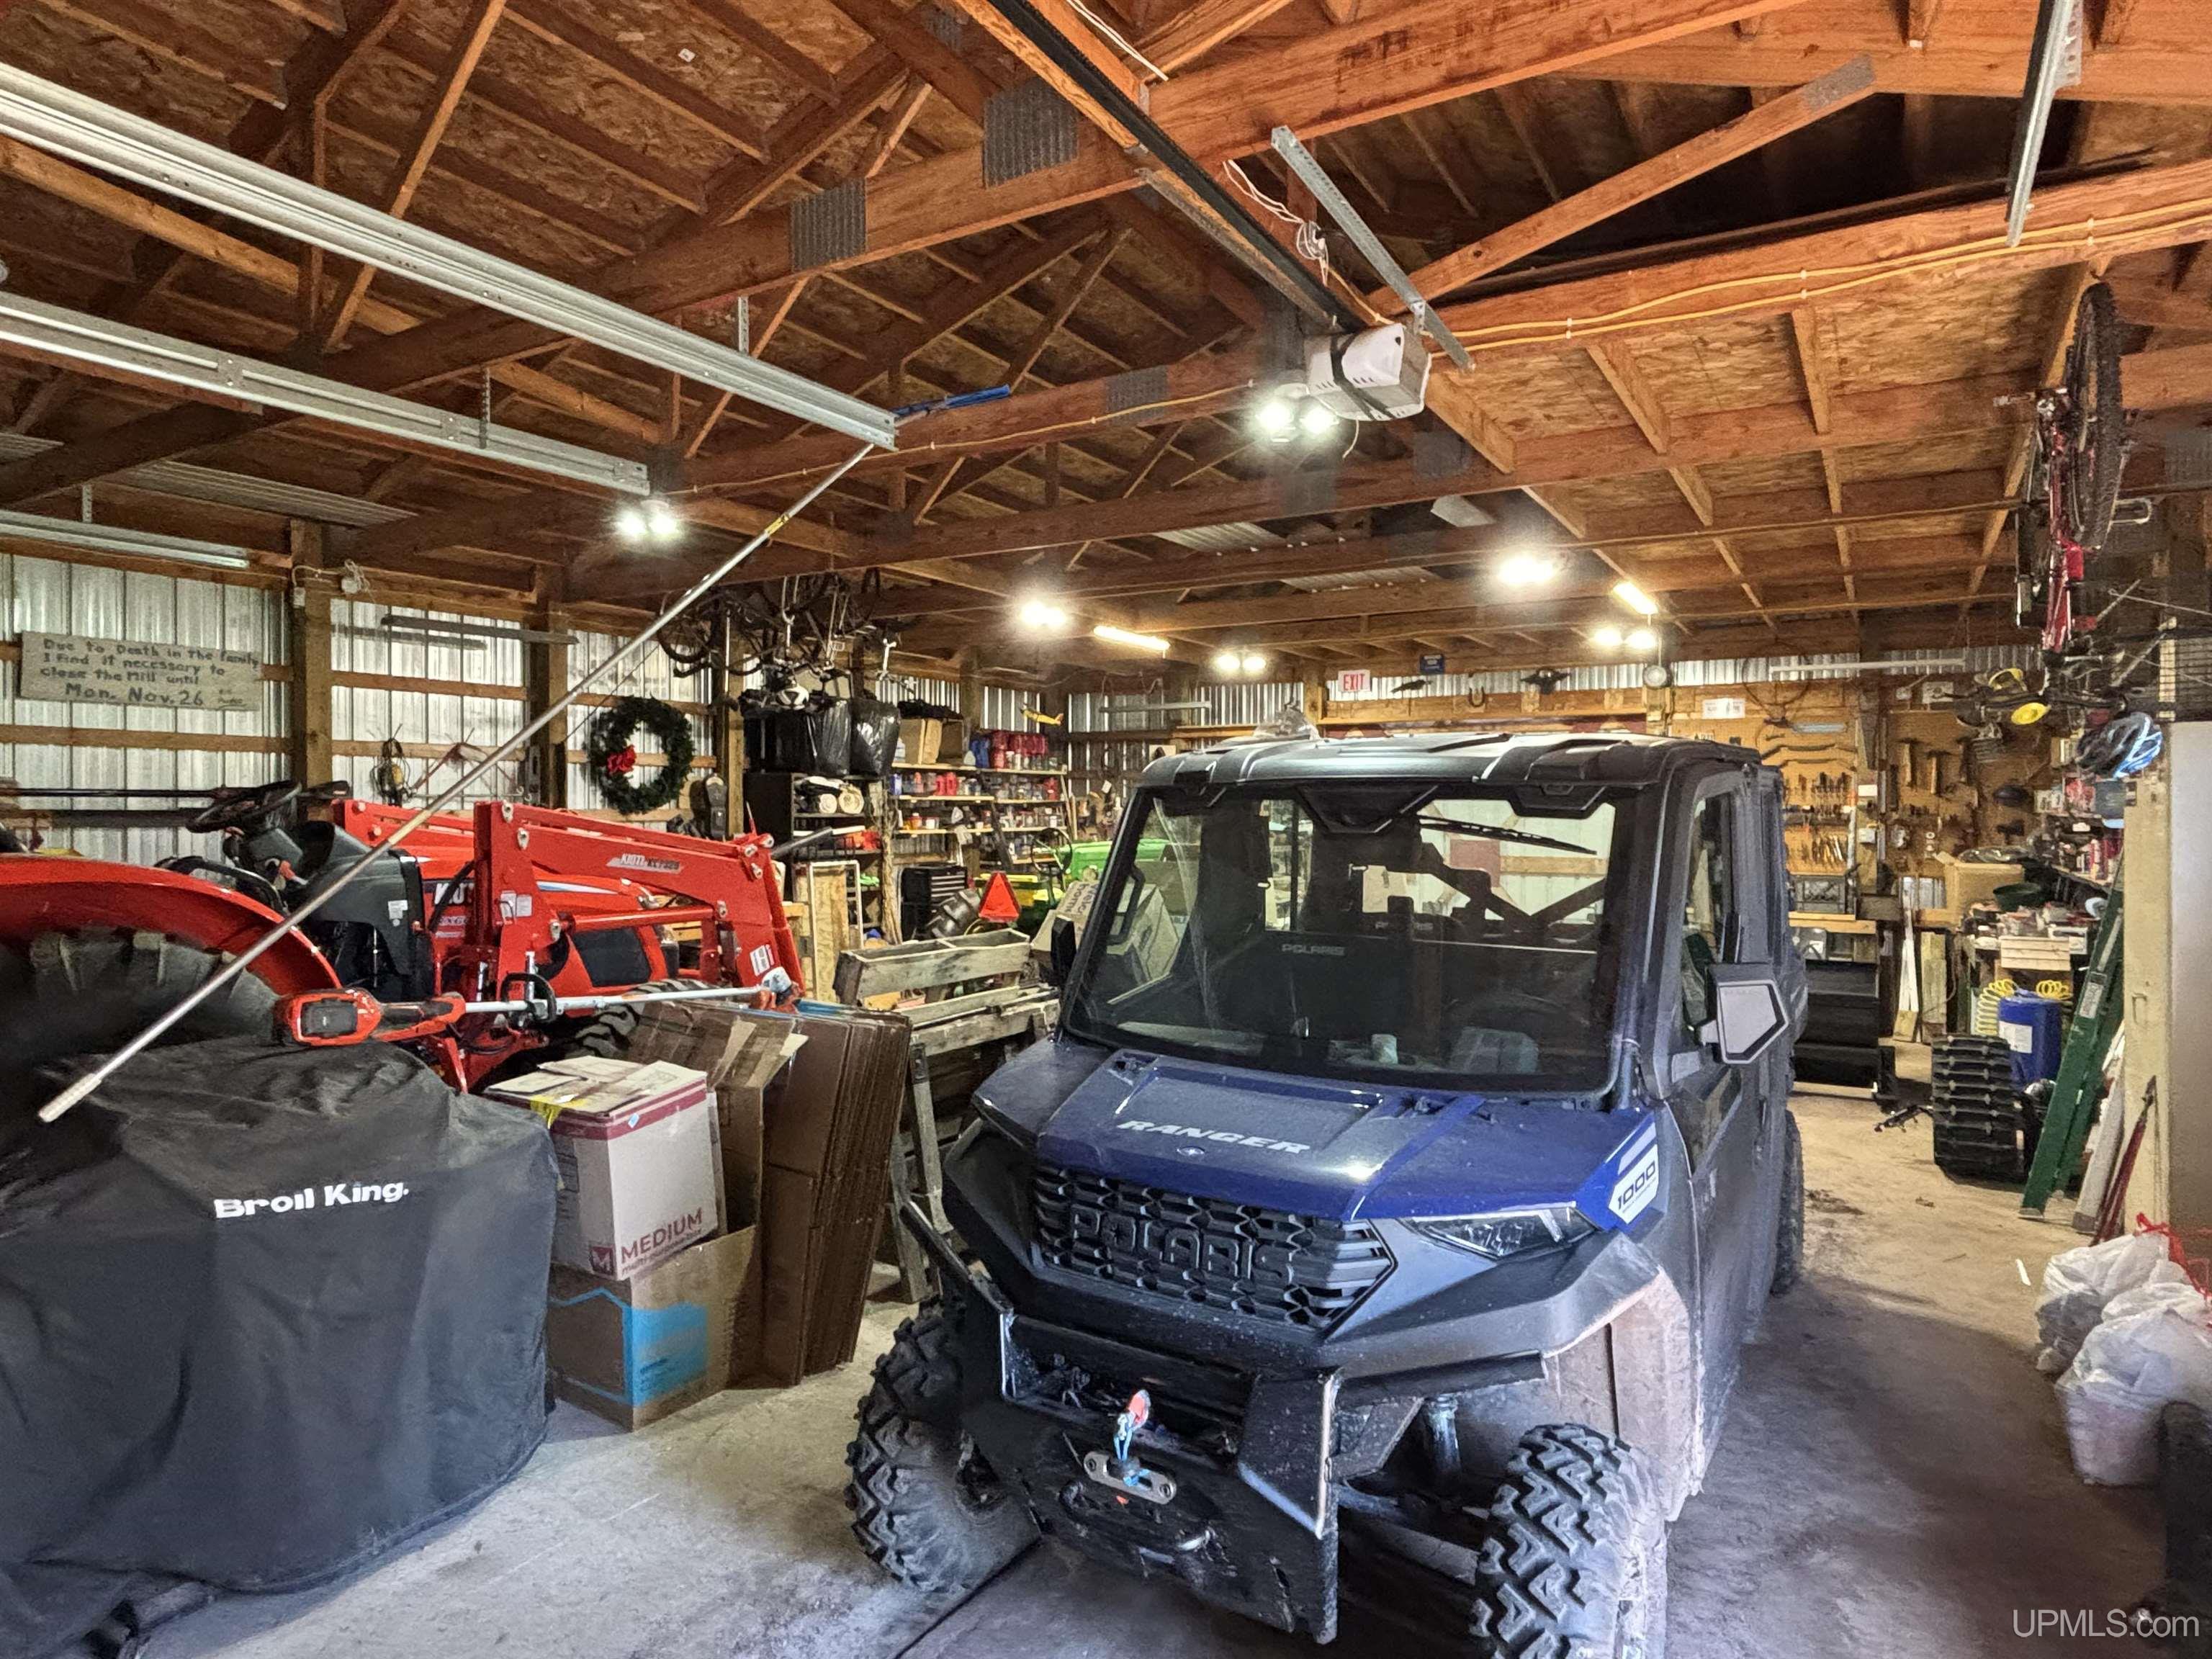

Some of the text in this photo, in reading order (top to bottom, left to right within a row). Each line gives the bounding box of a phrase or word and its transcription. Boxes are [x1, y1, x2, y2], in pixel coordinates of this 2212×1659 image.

[43, 638, 75, 651] Due
[86, 640, 105, 654] to
[116, 644, 159, 657] Death
[166, 648, 181, 658] in
[44, 652, 50, 662] I
[123, 660, 201, 675] necessary
[209, 663, 225, 675] to
[166, 675, 199, 684] until
[1343, 673, 1365, 691] EXIT
[66, 683, 117, 699] Mon.
[128, 687, 175, 703] Nov.
[179, 689, 204, 706] 26
[1281, 943, 1346, 956] POLARIS
[1117, 1120, 1310, 1154] RANGER
[1617, 1160, 1656, 1210] 1000
[214, 1187, 315, 1219] Broil
[621, 1207, 703, 1264] MEDIUM
[1069, 1204, 1282, 1282] POLARIS
